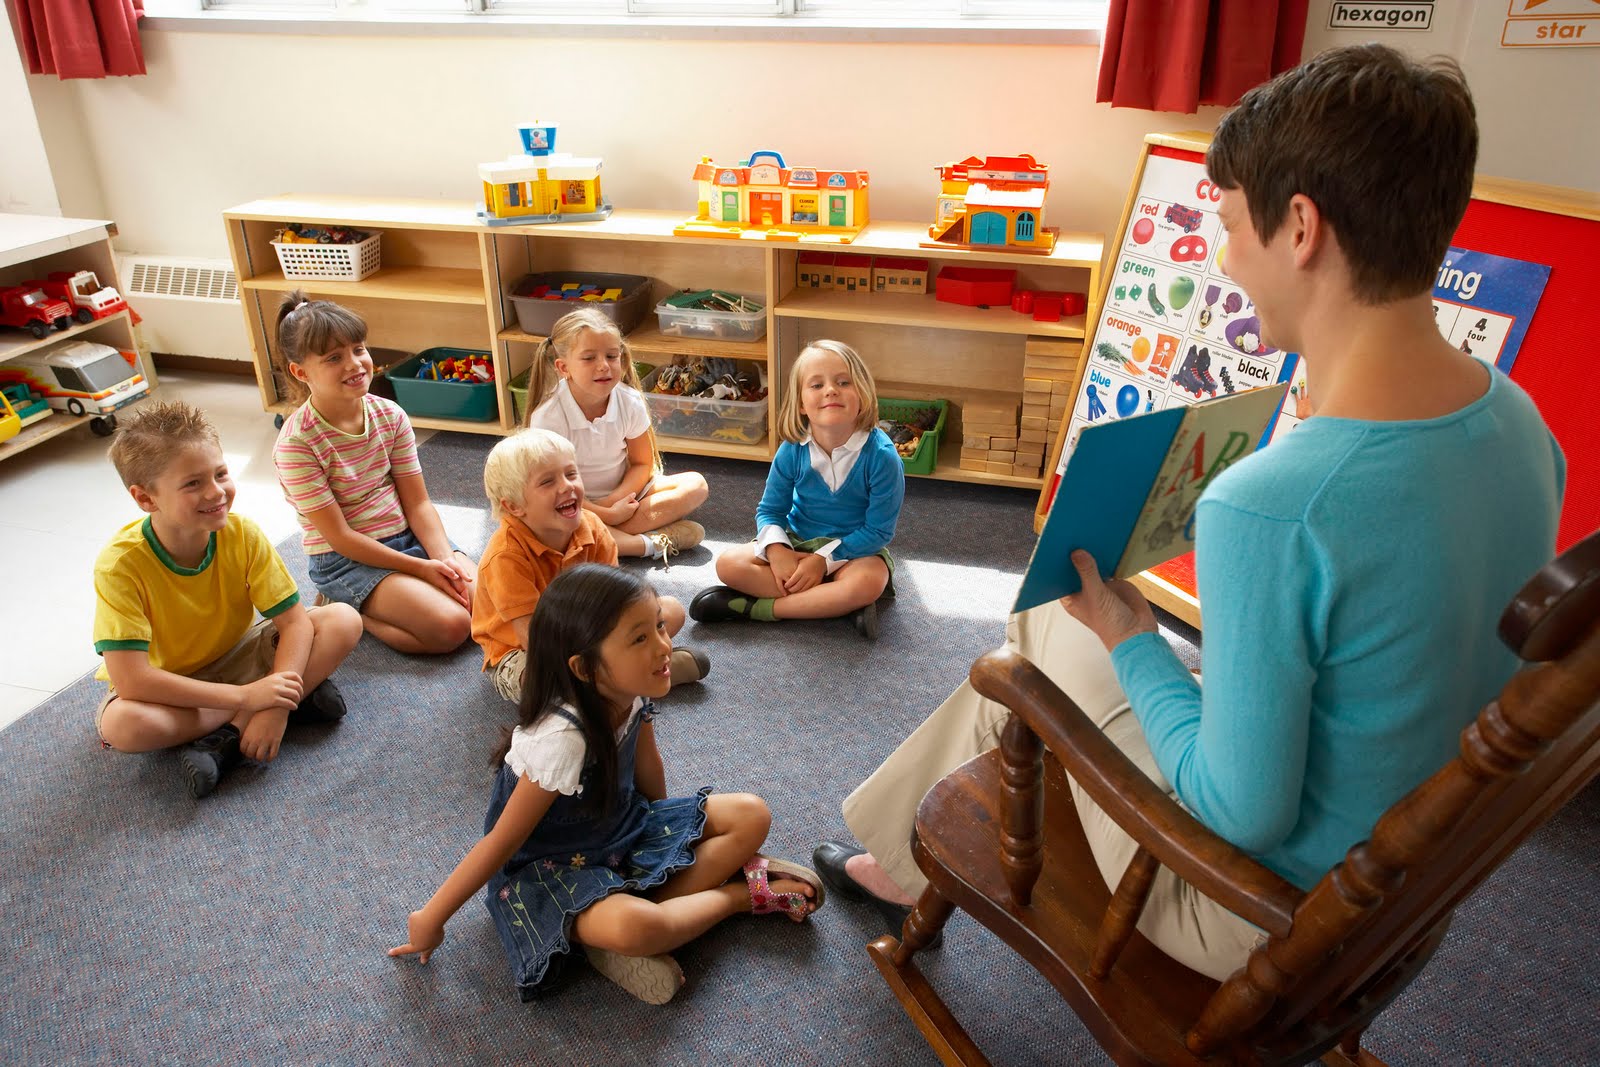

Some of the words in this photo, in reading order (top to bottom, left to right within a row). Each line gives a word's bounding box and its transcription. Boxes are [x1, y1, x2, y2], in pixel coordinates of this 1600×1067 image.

[1336, 6, 1427, 25] hexagon
[1535, 22, 1587, 38] star
[1140, 203, 1159, 216] red
[1122, 260, 1155, 278] green
[1438, 260, 1482, 300] ing
[1107, 317, 1141, 336] orange
[1475, 318, 1487, 331] 4
[1467, 330, 1486, 342] four
[1090, 369, 1111, 388] blue
[1237, 358, 1270, 381] black
